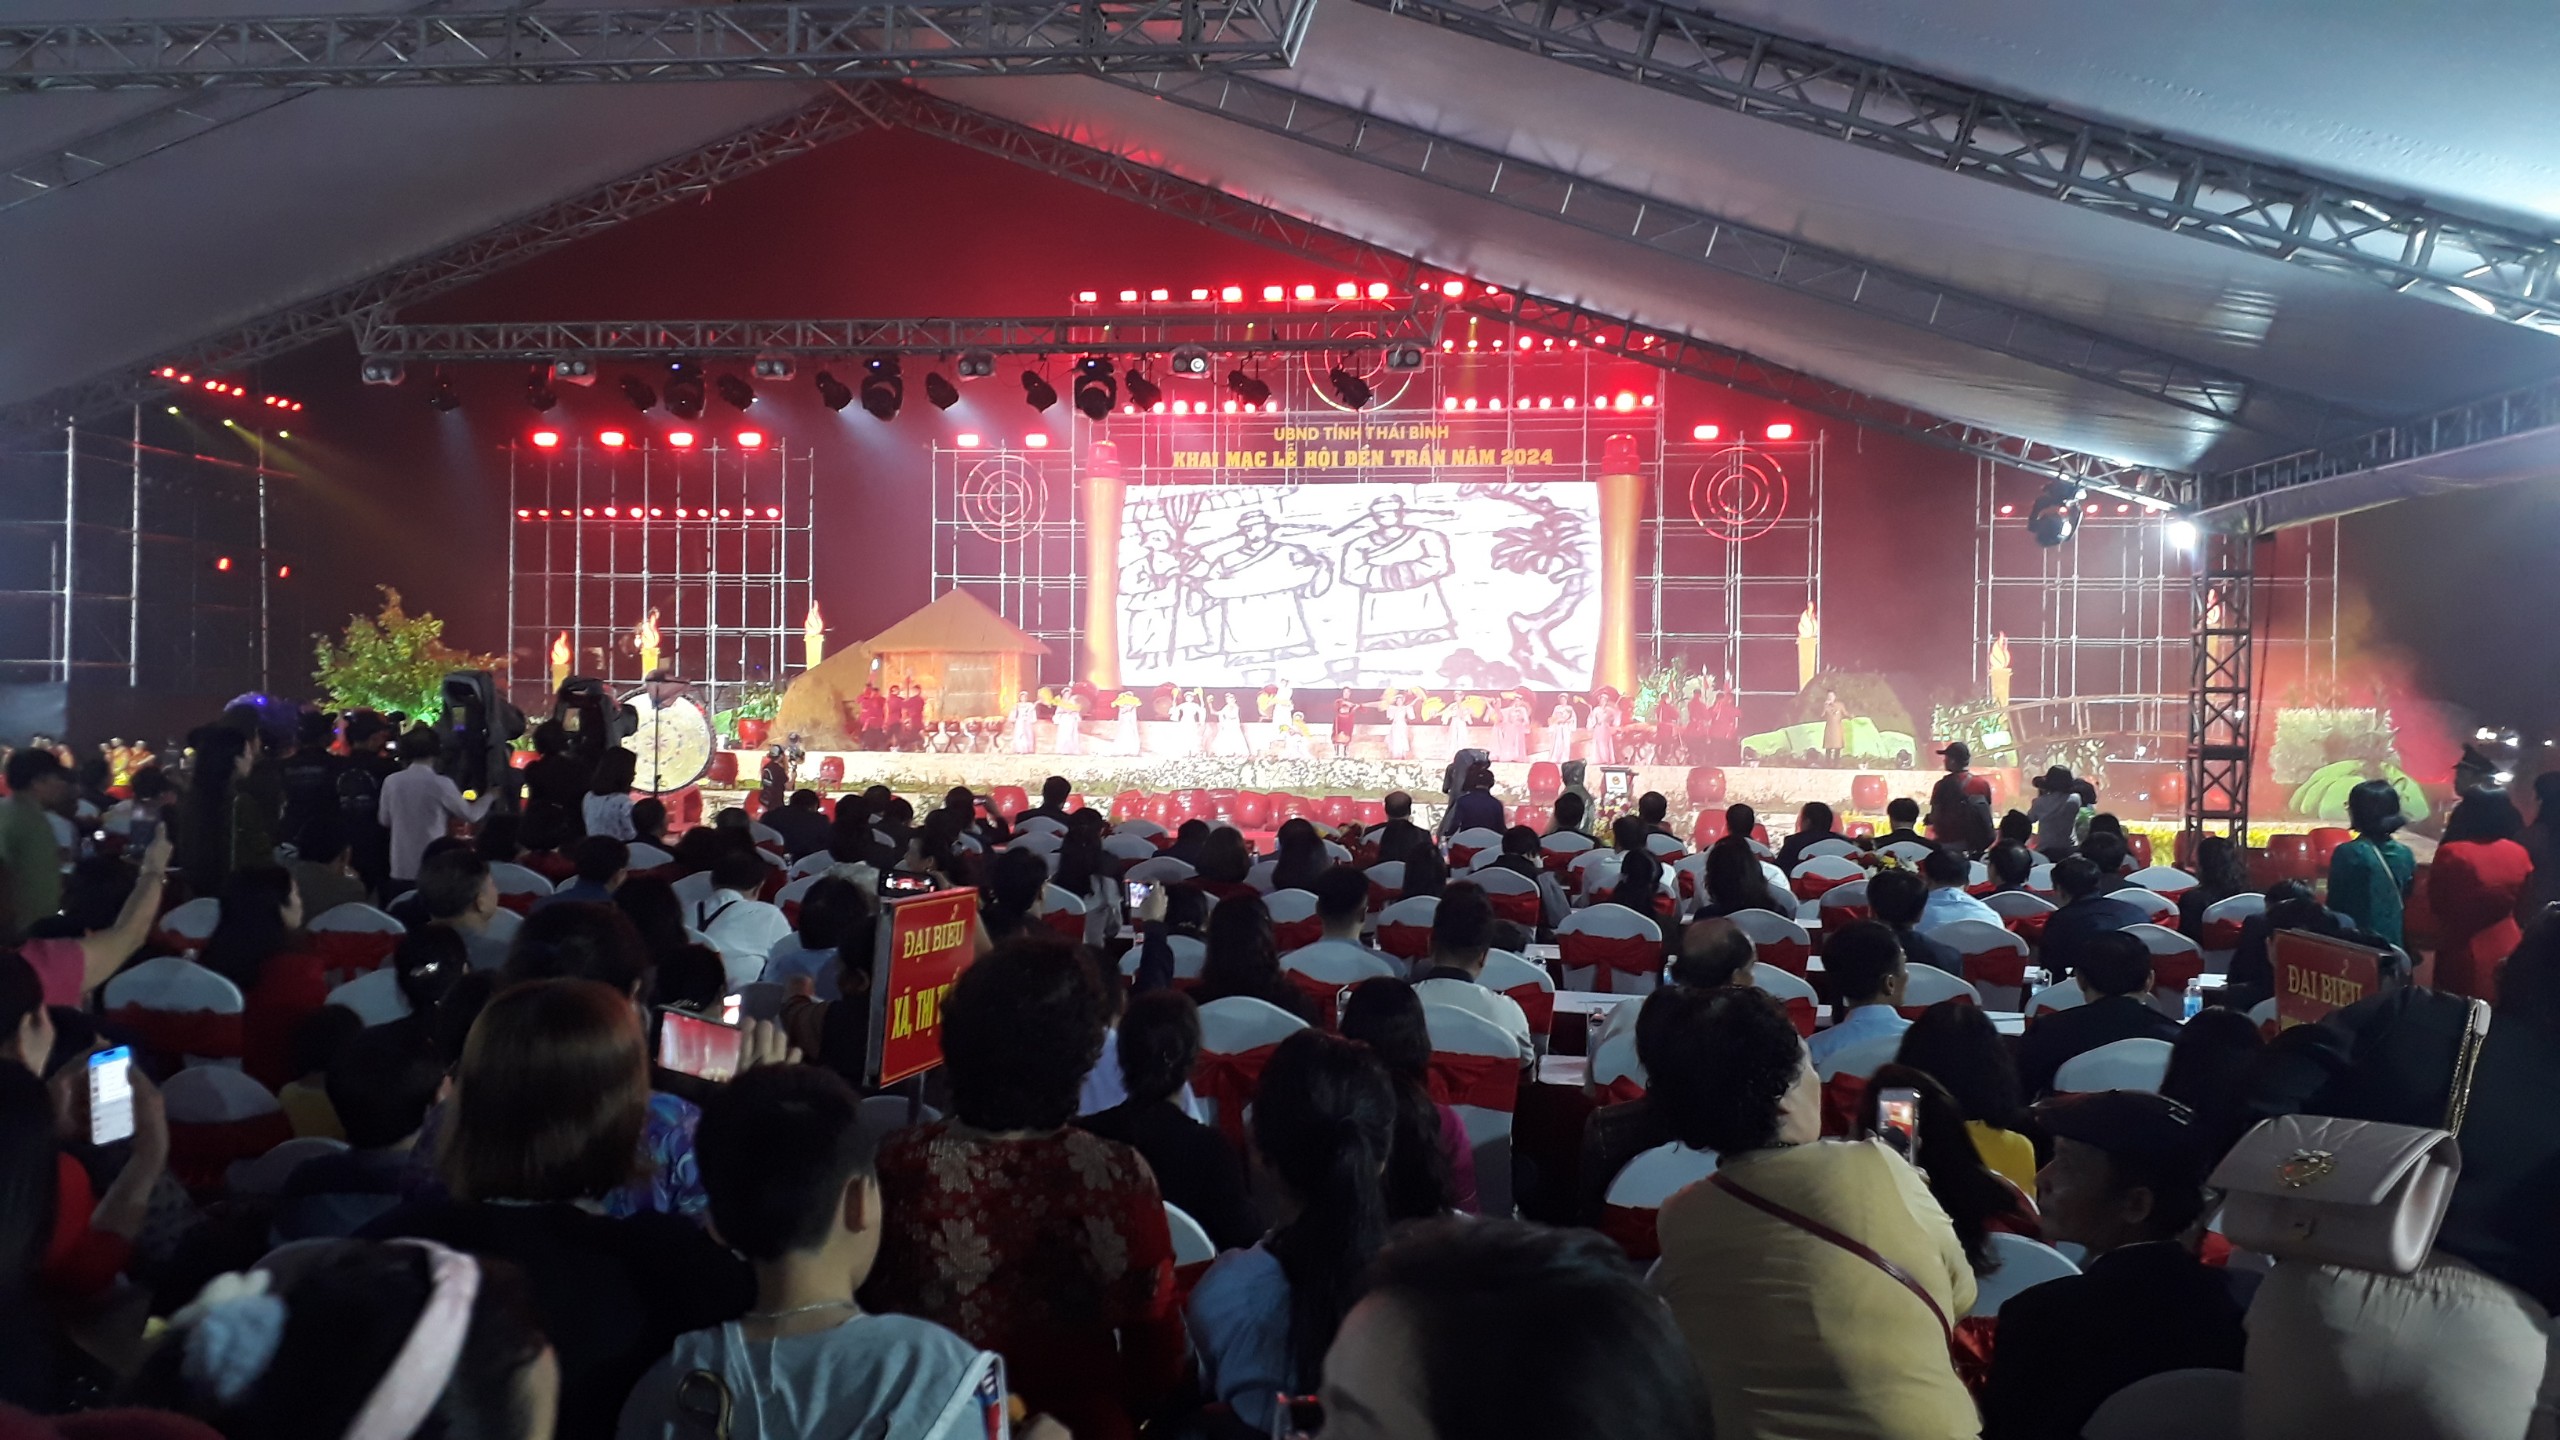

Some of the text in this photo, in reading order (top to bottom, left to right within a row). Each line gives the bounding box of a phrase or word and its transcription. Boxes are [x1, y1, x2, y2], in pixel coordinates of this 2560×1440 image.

[1273, 426, 1320, 441] UBND
[1365, 421, 1405, 440] THÁI
[1173, 451, 1220, 468] KHAI
[1226, 451, 1267, 471] MẠC
[1304, 446, 1339, 471] HỘI
[1450, 445, 1496, 467] NĂM
[1501, 448, 1553, 466] 2024
[903, 903, 967, 963] ĐẠI BIỂU
[2287, 964, 2318, 1005] ĐẠI
